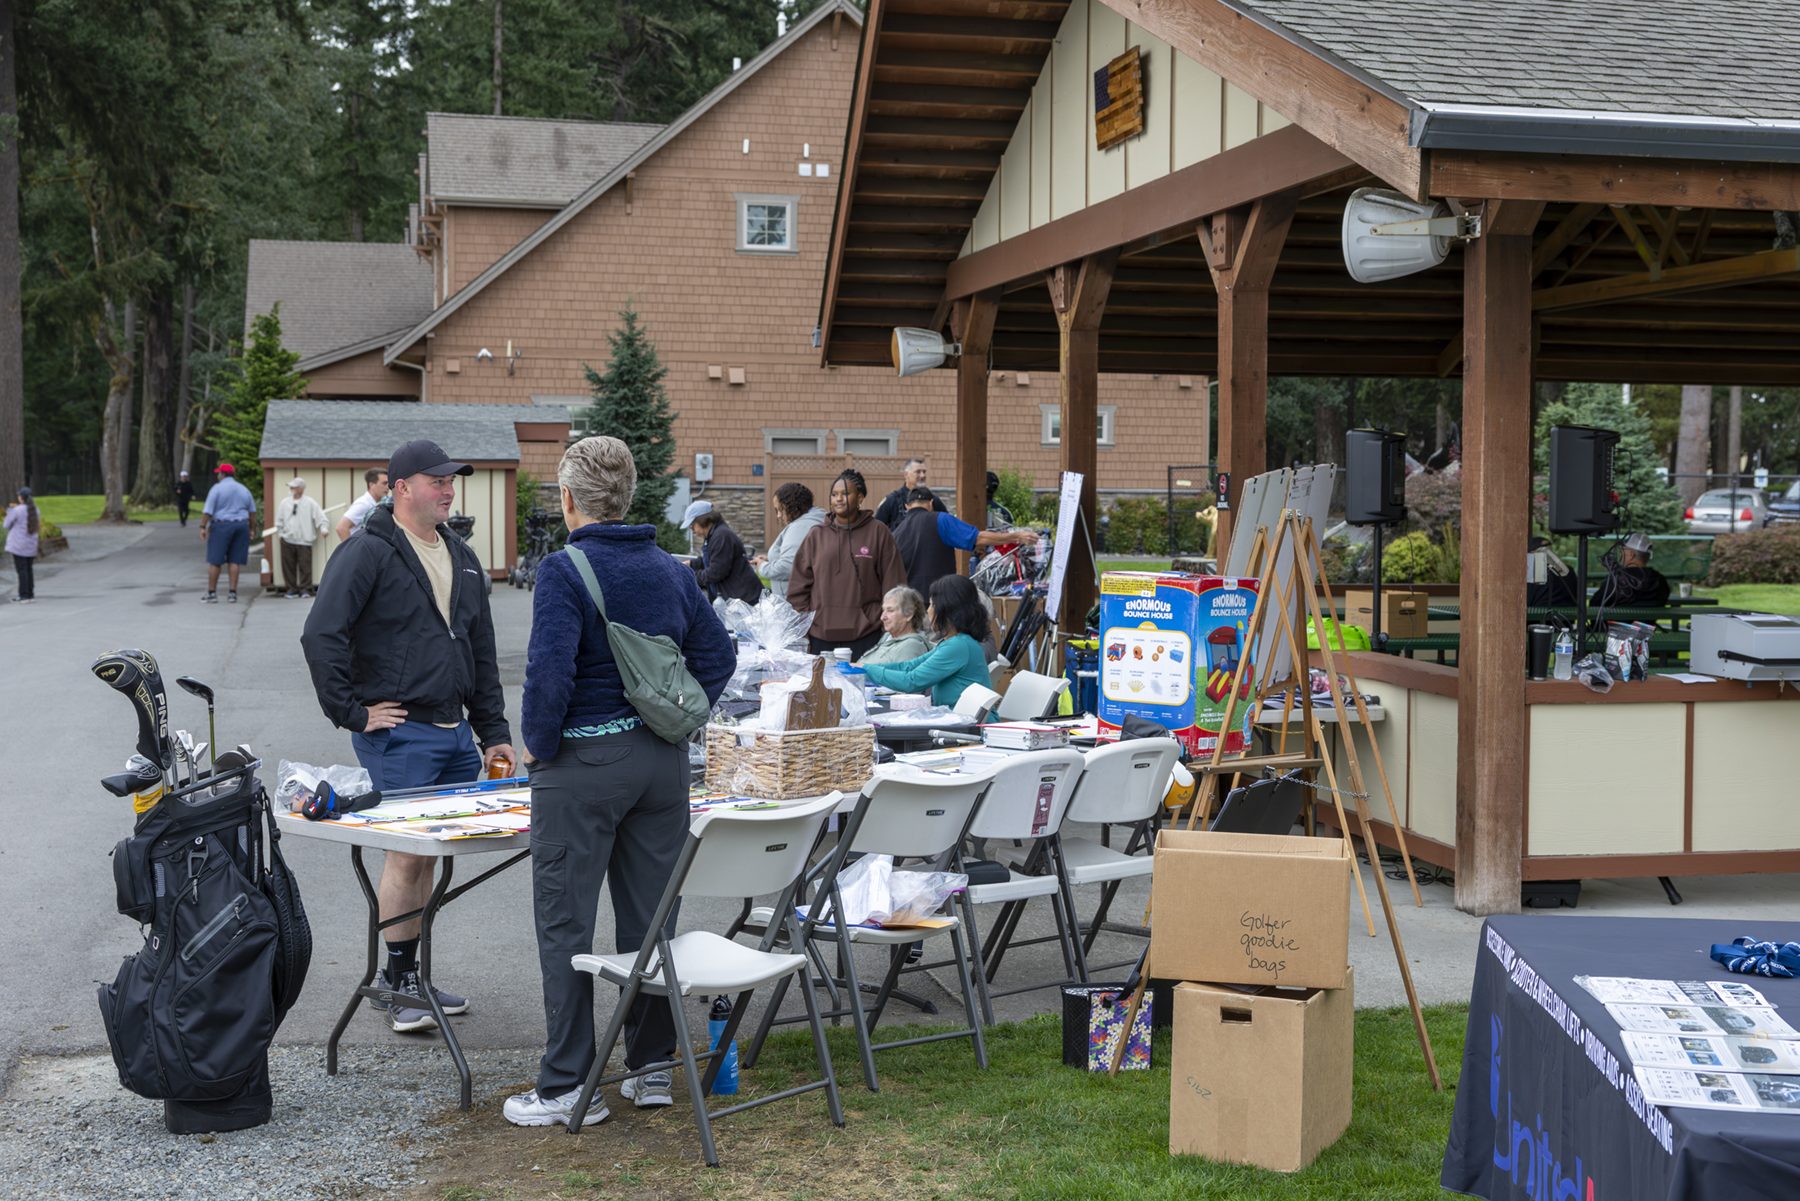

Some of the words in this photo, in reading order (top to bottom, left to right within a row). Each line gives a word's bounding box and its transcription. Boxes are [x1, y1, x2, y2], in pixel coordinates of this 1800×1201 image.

[1125, 599, 1171, 612] ENORMOUS
[1212, 593, 1247, 608] ENORMOUS
[1123, 610, 1150, 619] BOUNCE
[1151, 612, 1173, 620] HOUSE
[1210, 609, 1231, 617] BOUNCE
[1231, 608, 1247, 616] HOUSE
[155, 692, 168, 738] PING
[1240, 910, 1291, 935] Golfer
[1240, 932, 1300, 955] goodie
[1248, 951, 1286, 980] bags
[1566, 1007, 1581, 1046] LIFTS
[1646, 1103, 1674, 1156] SEATING
